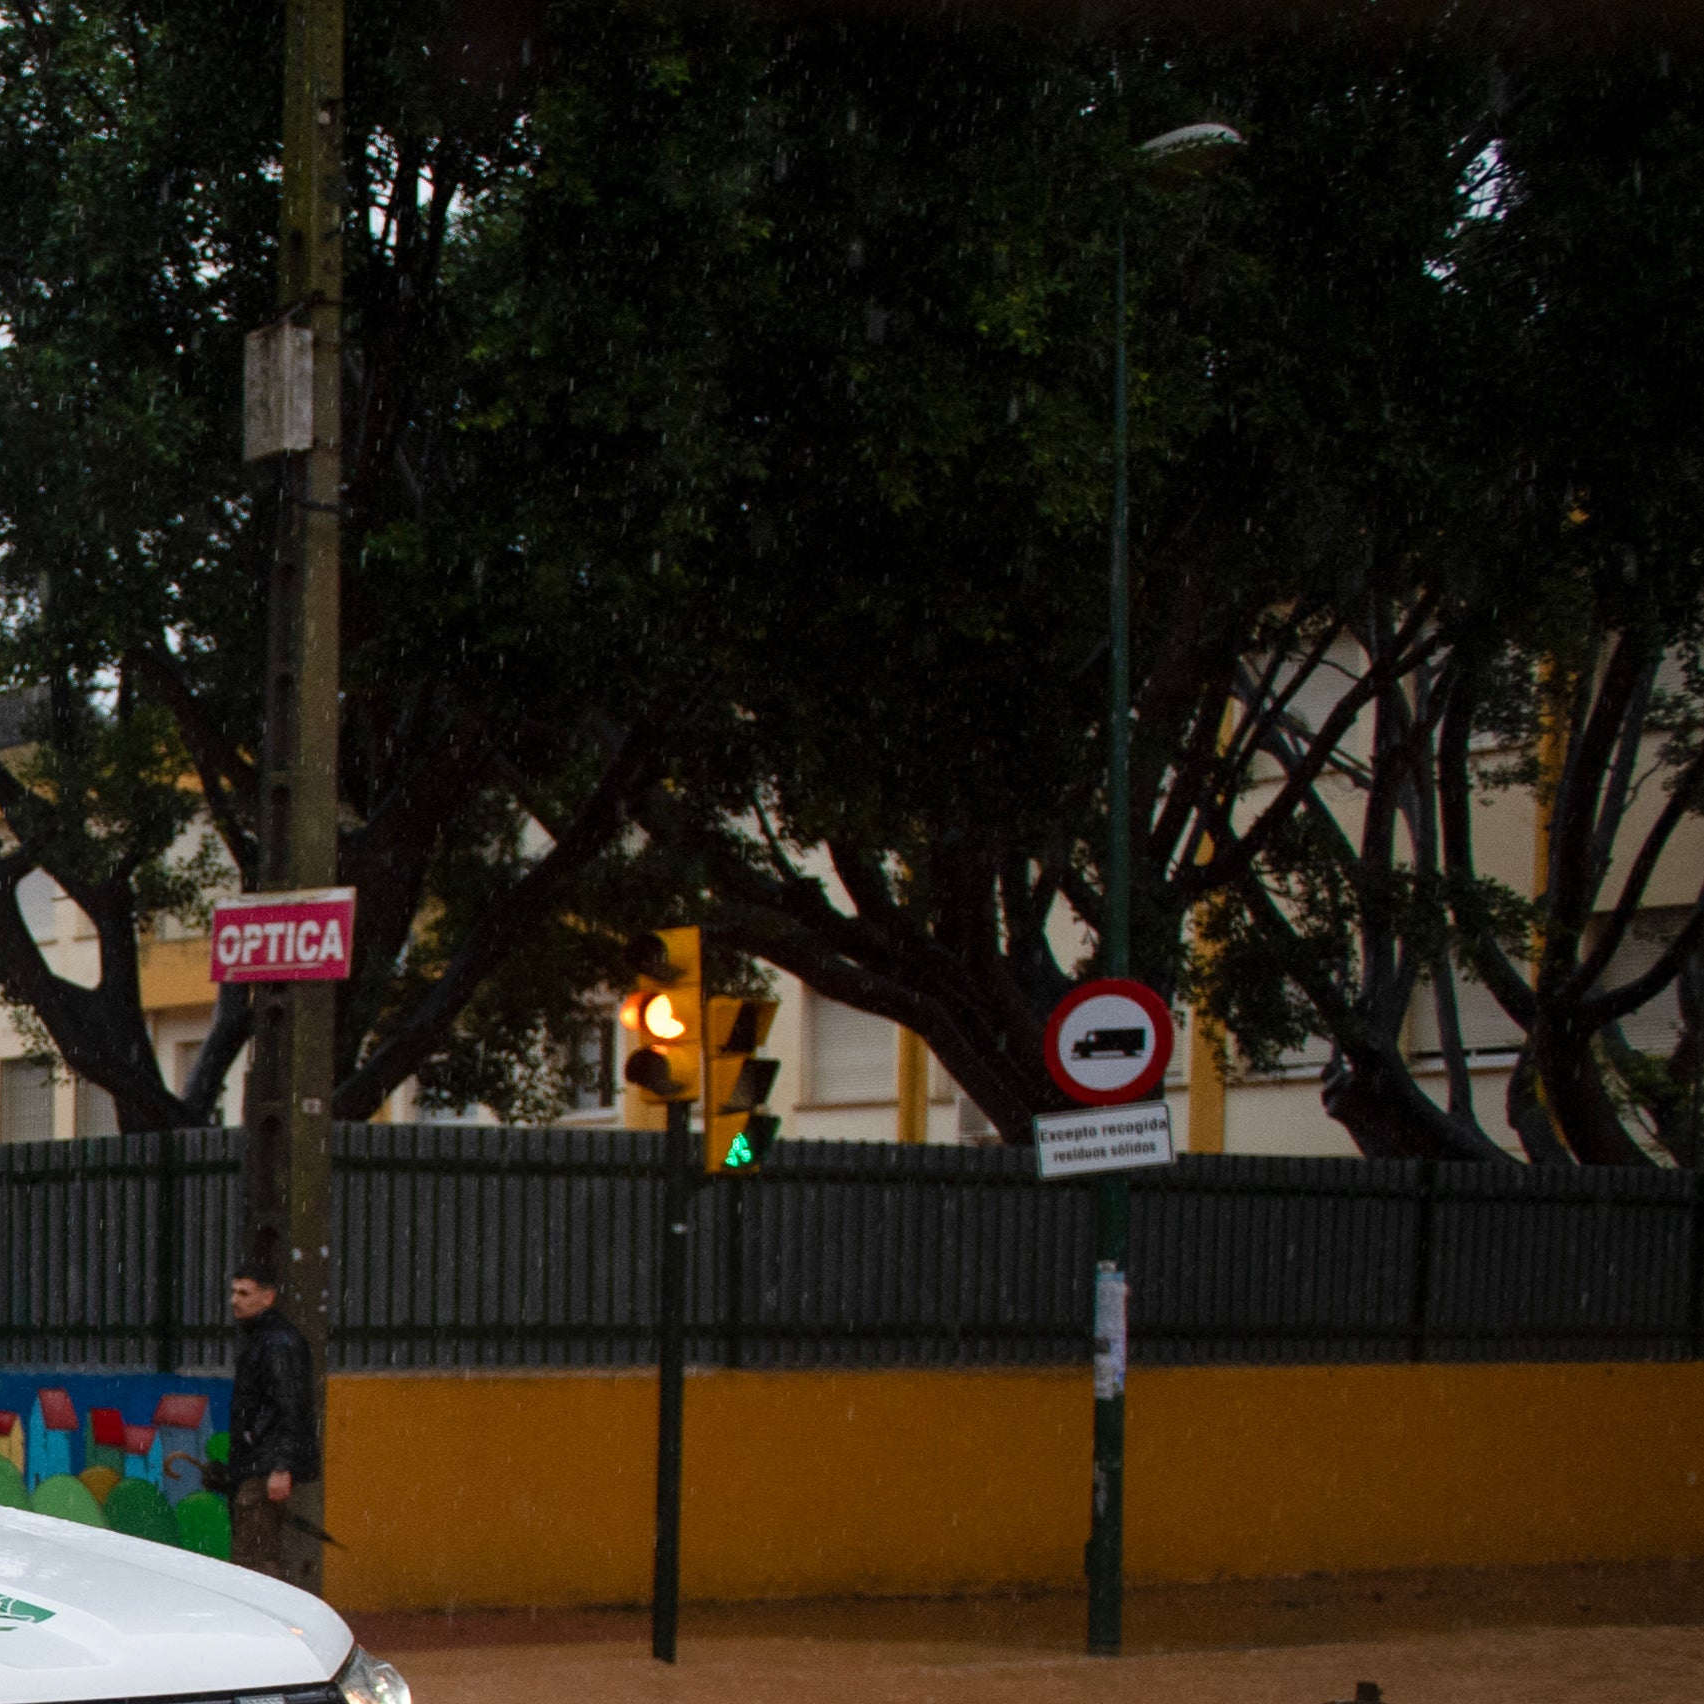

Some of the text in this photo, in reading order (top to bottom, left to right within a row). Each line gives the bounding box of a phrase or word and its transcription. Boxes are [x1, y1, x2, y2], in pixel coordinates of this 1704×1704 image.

[217, 919, 345, 966] OPTICA
[1039, 1118, 1168, 1144] Excepto recogida
[1053, 1141, 1157, 1163] residuos sólidos
